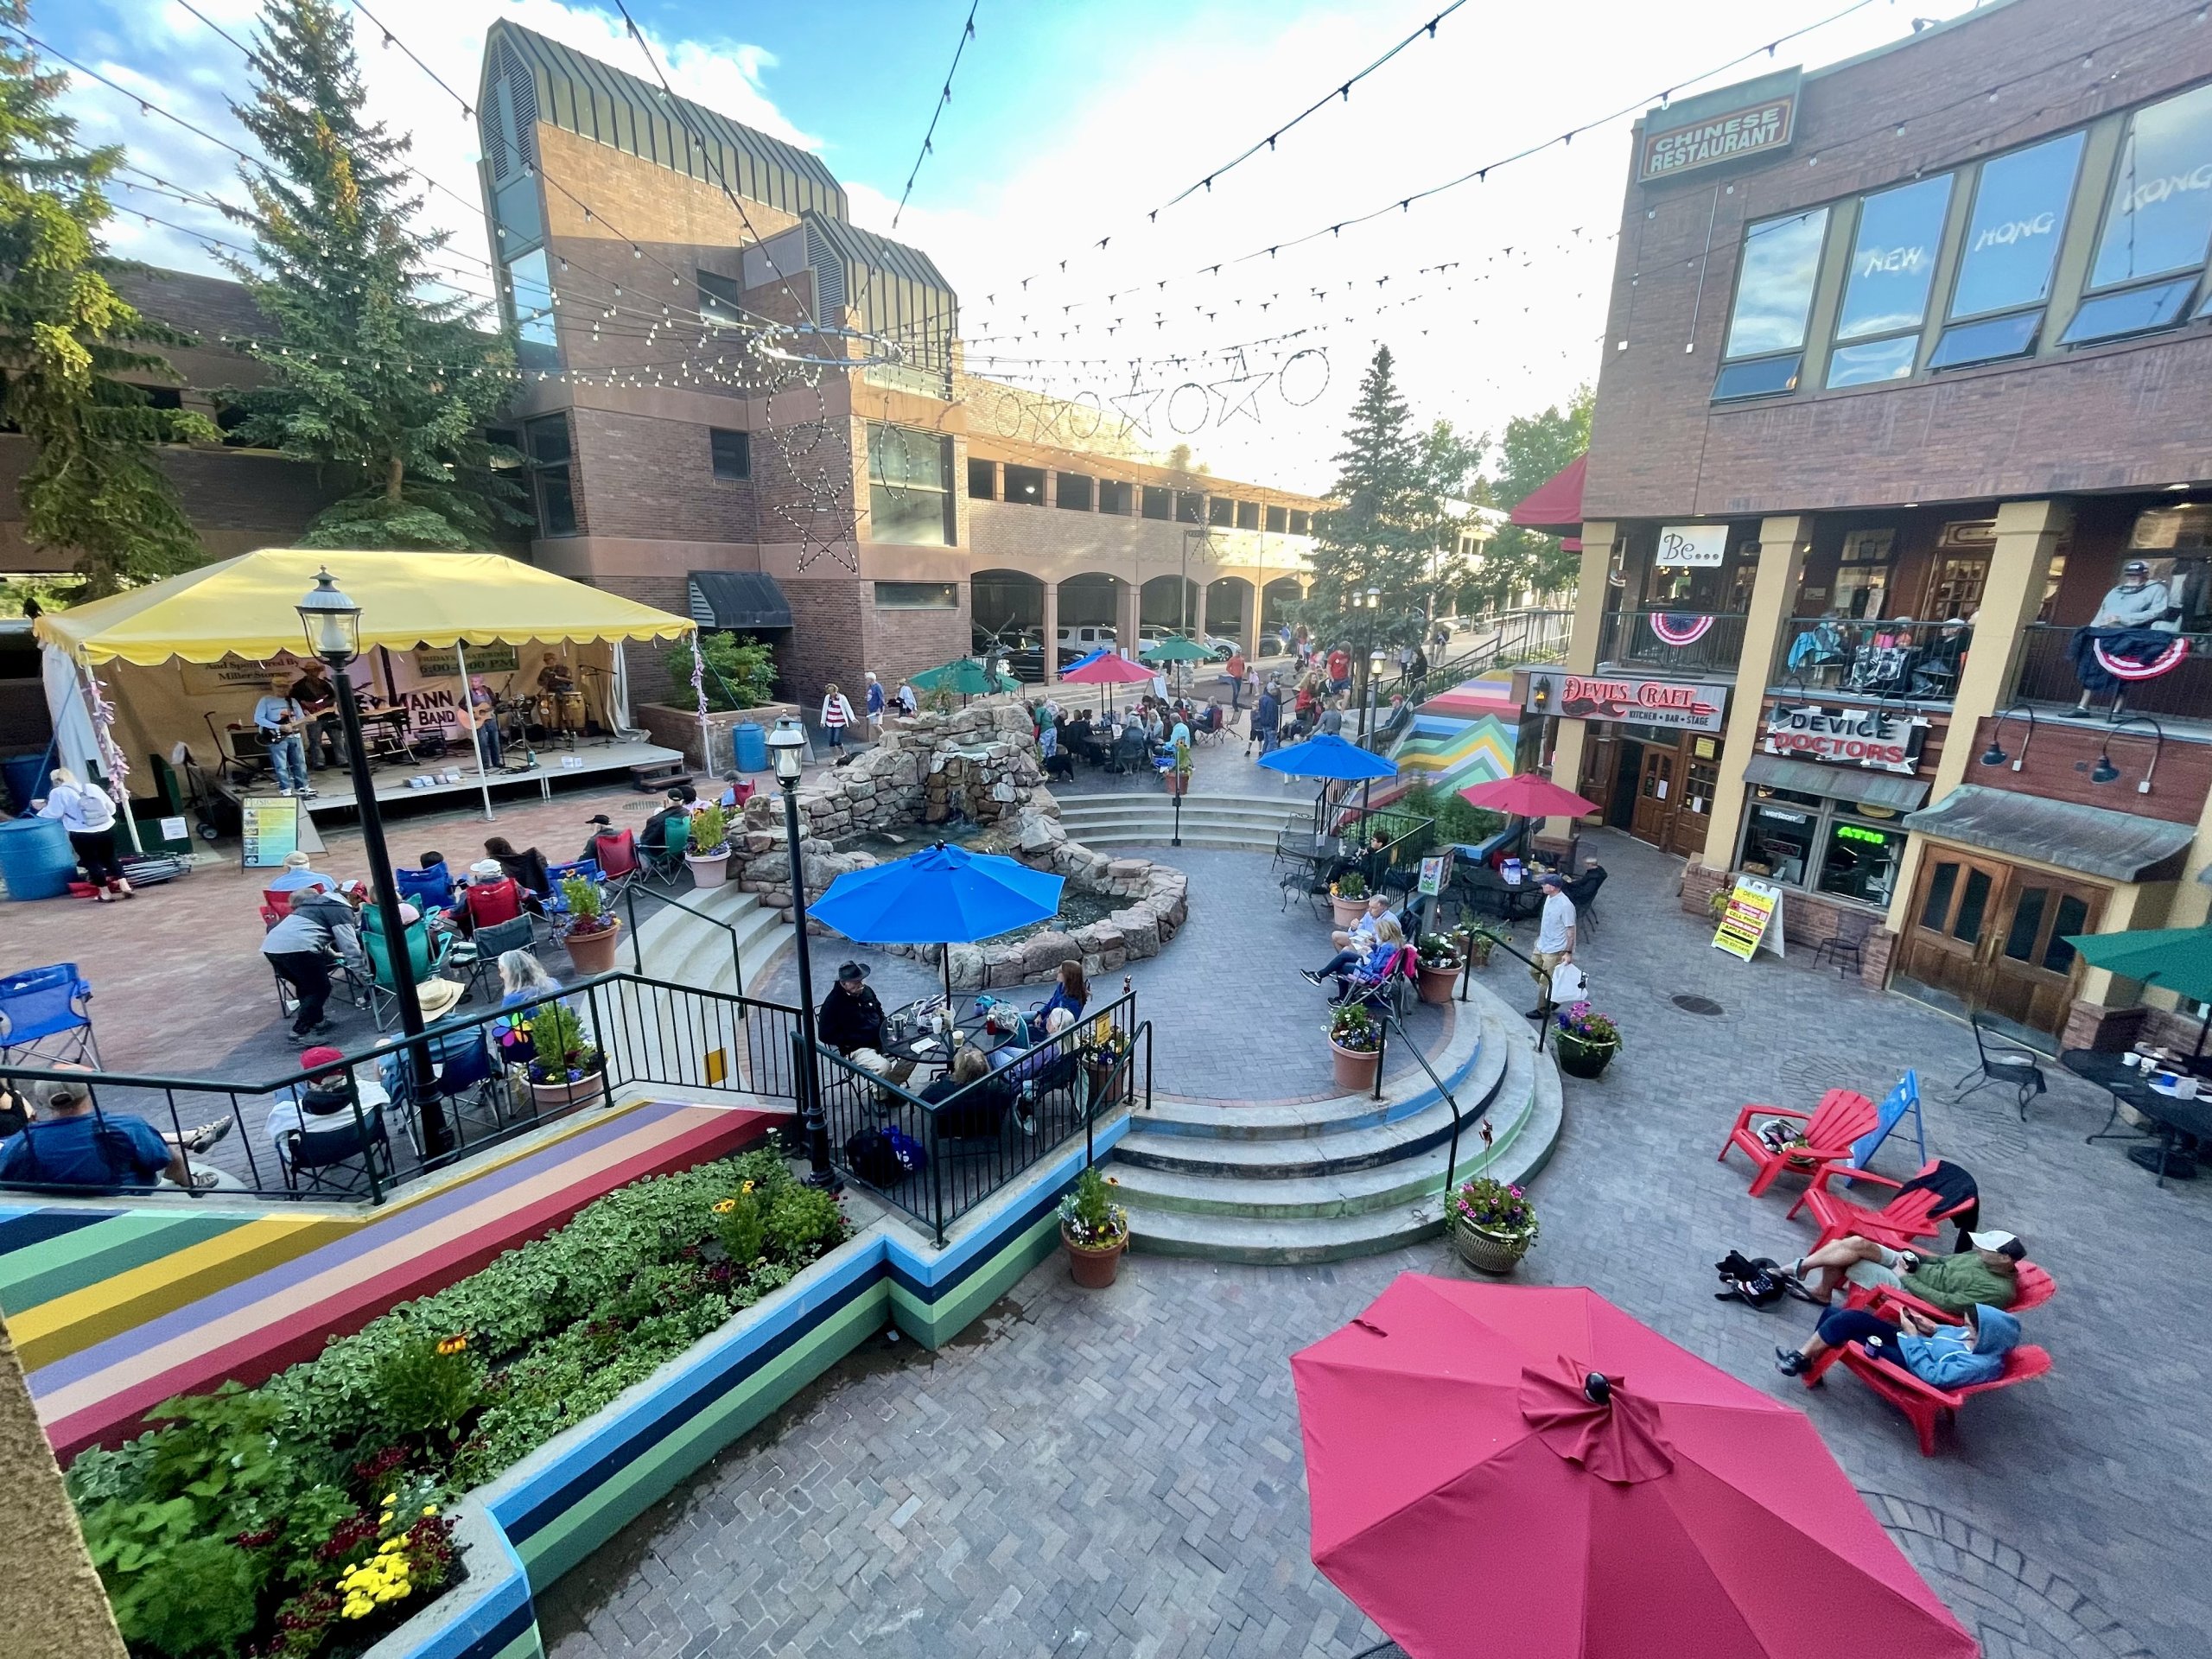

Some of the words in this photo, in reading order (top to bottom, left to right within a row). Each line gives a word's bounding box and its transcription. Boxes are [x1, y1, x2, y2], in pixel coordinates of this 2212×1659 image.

[1656, 107, 1780, 152] CHINESE
[1649, 121, 1781, 174] RESTAURANT
[1864, 246, 1923, 278] NEW
[1974, 212, 2056, 252] HONG
[2121, 162, 2212, 212] KONG
[206, 661, 227, 671] And
[286, 657, 299, 667] By
[490, 658, 514, 669] PM
[218, 671, 251, 682] Miller
[1637, 681, 1696, 709] CRAFT
[418, 710, 455, 725] BAND
[1629, 710, 1658, 721] KITCHEN
[1664, 713, 1680, 723] BAR
[1686, 715, 1710, 727] STAGE
[1790, 713, 1894, 740] DEVICE
[1775, 732, 1905, 764] DOCTORS
[1764, 810, 1799, 822] verizon
[1837, 825, 1885, 844] ATM
[1742, 890, 1765, 902] DEVICE
[1729, 911, 1742, 919] CELL
[1743, 915, 1763, 926] PHONE
